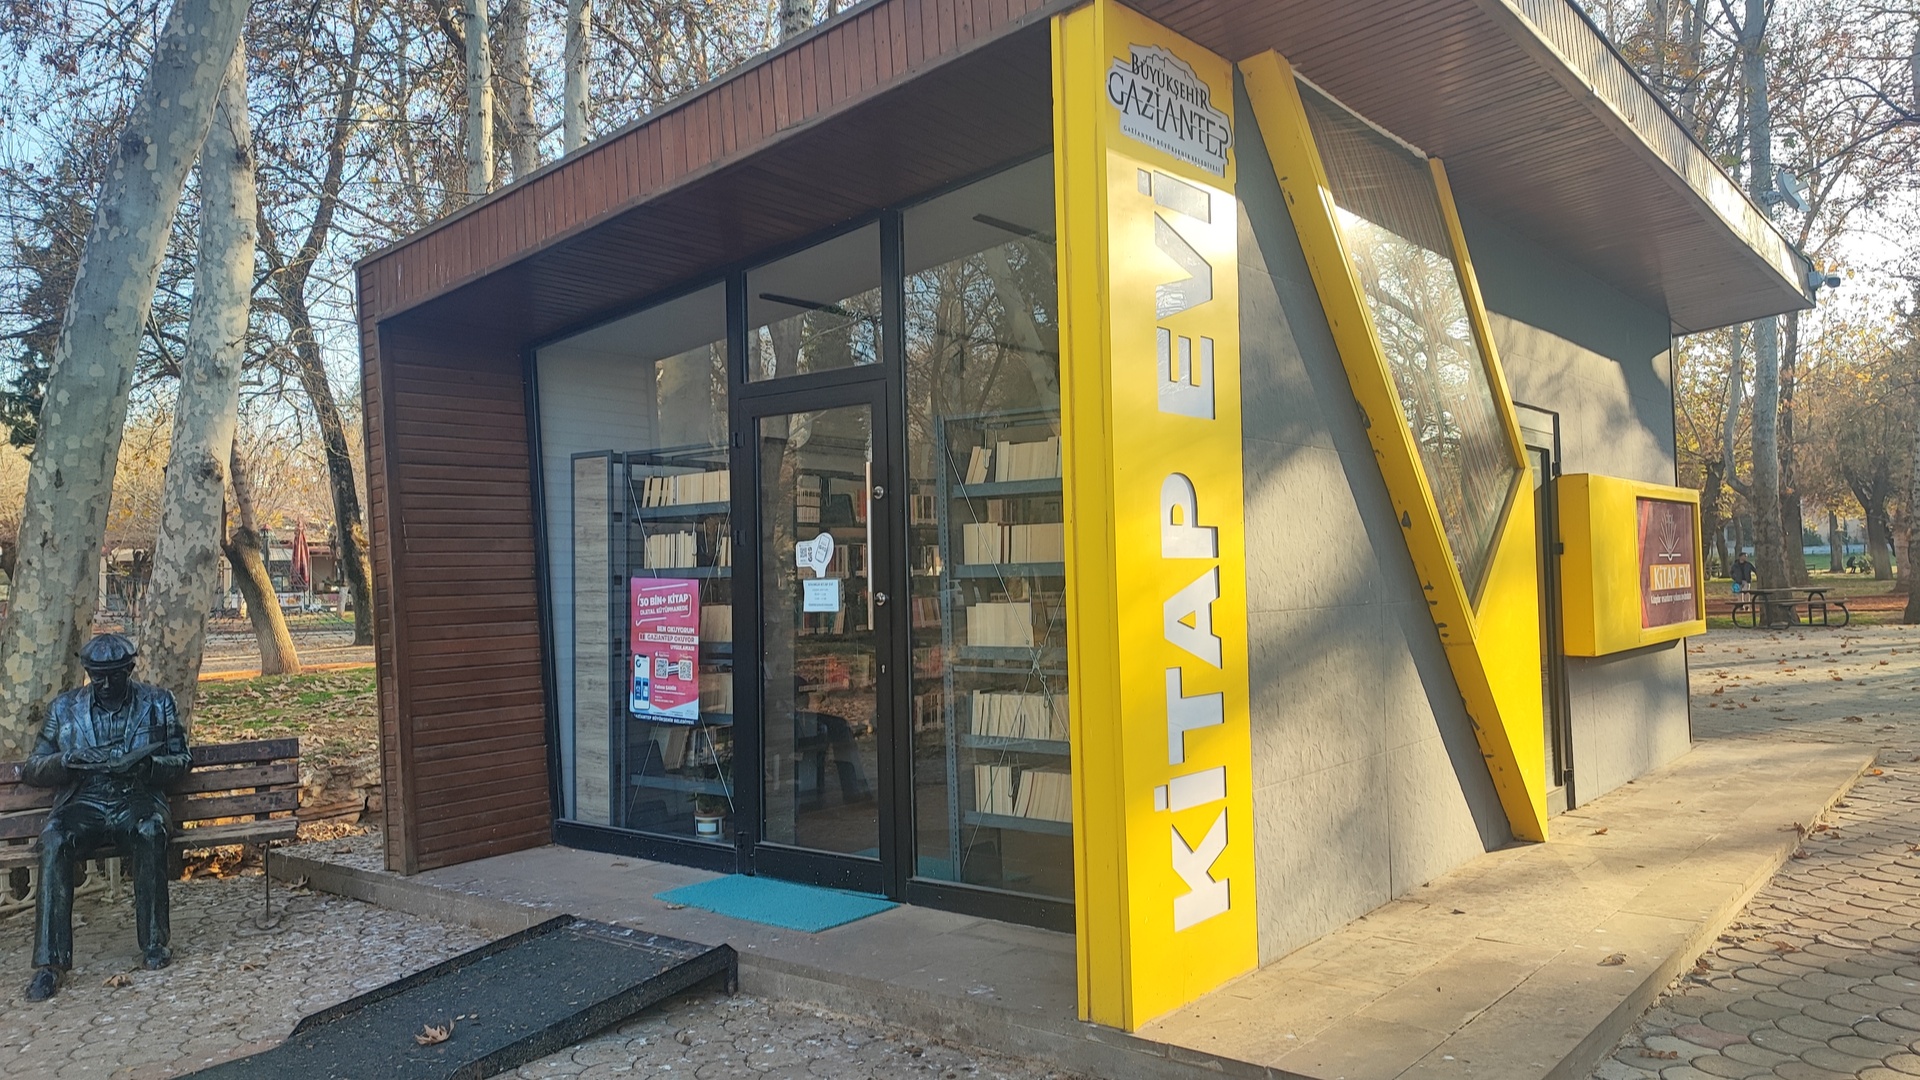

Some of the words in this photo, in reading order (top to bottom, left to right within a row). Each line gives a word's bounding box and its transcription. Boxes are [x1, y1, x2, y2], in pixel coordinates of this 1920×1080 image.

[1108, 71, 1229, 160] GAZİANTEP
[1137, 167, 1216, 420] EVİ
[667, 593, 689, 604] KİTAP
[1654, 564, 1676, 590] KİTAP
[1679, 563, 1691, 588] EVİ
[1154, 472, 1231, 933] KİTAP
